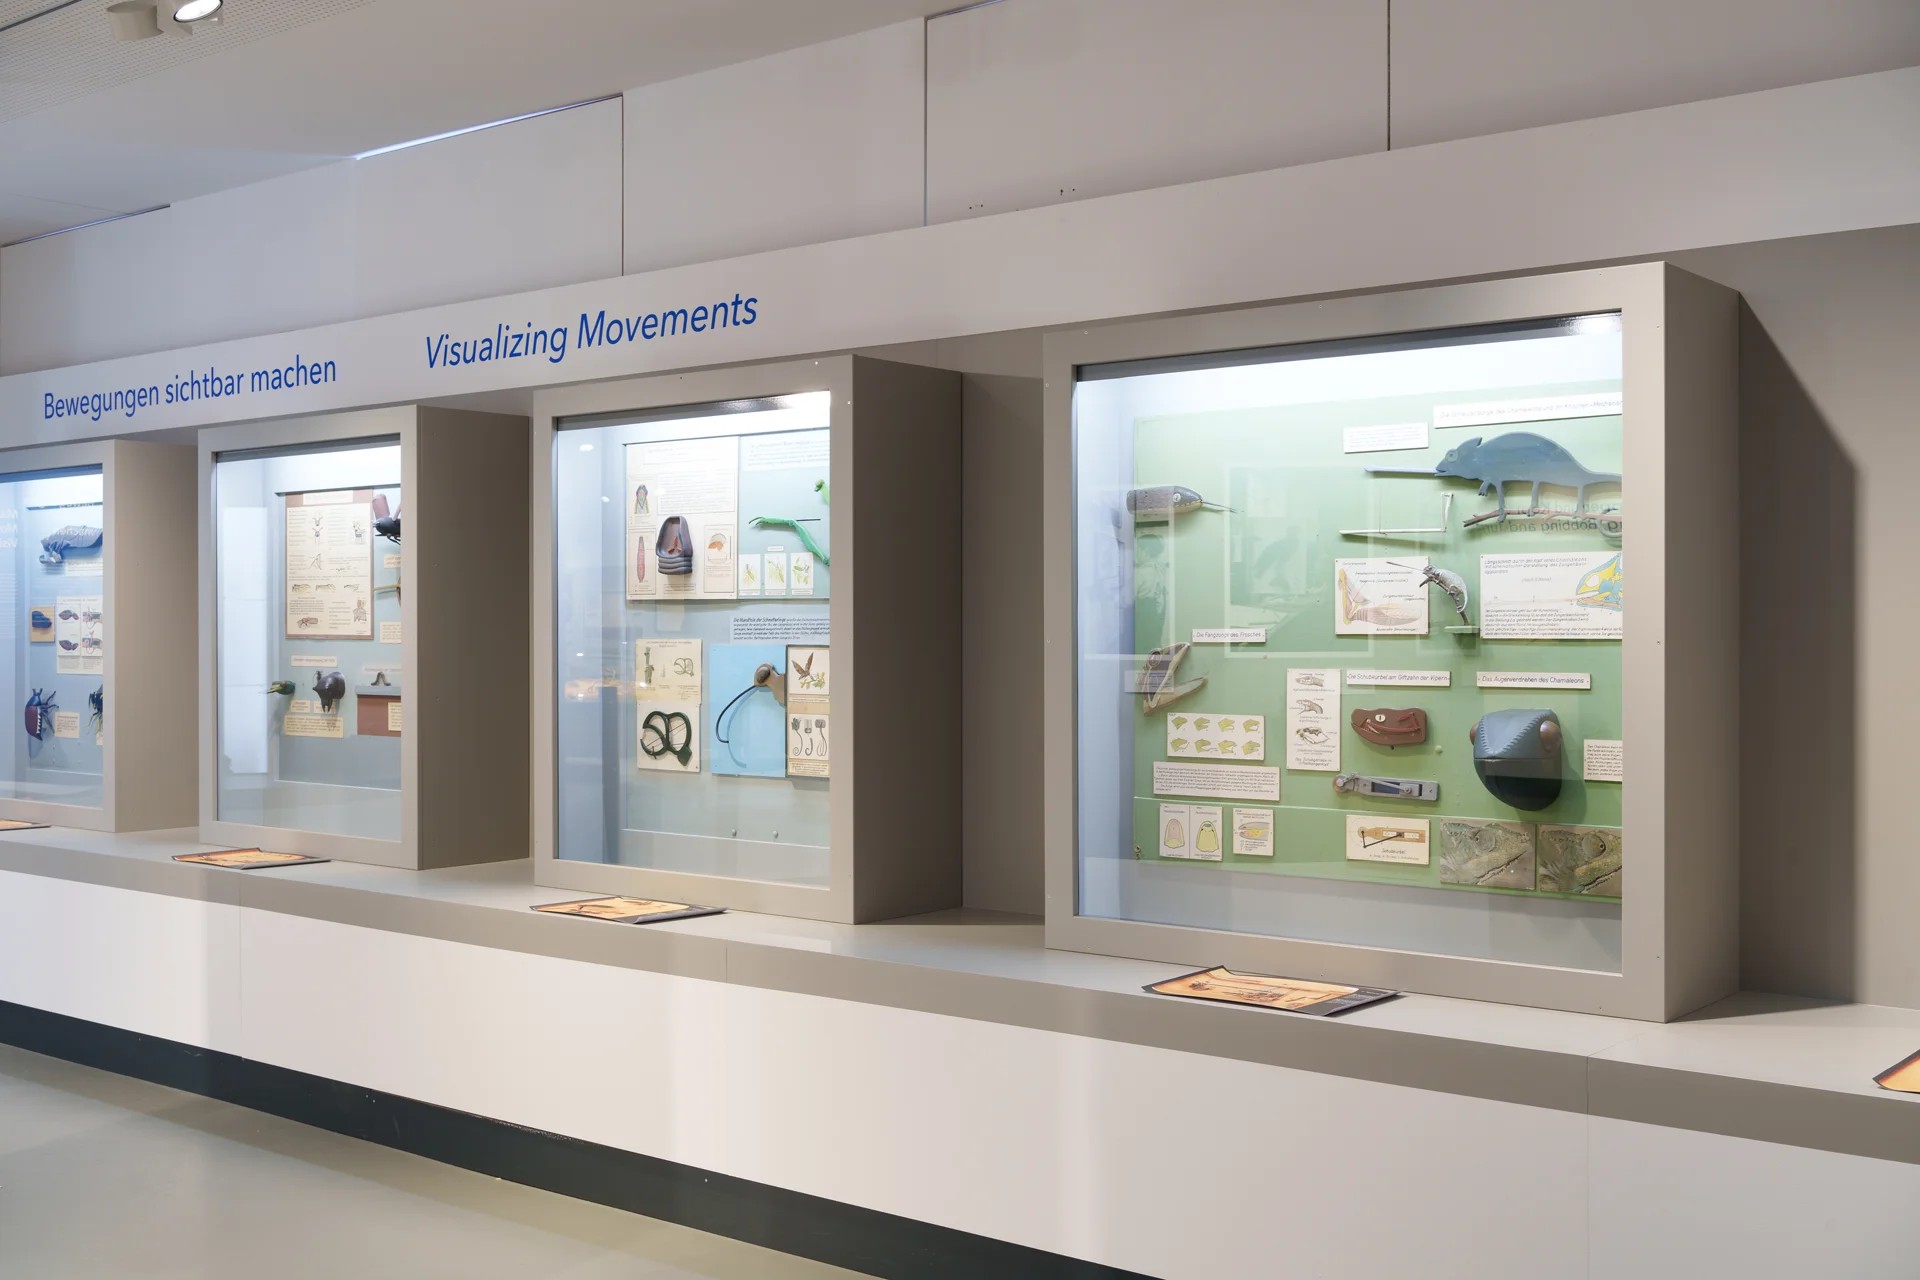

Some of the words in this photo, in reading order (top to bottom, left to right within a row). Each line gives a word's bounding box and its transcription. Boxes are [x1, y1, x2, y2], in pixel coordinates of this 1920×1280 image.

[425, 322, 568, 369] Visualizing
[576, 293, 759, 350] Movements
[43, 385, 160, 422] Bewegungen
[165, 366, 245, 403] sichtbar
[250, 353, 337, 393] machen
[1205, 631, 1229, 639] Fangzunge
[1357, 673, 1388, 681] Schubkurbel
[1398, 674, 1419, 682] Giftzahn
[1420, 674, 1429, 682] der
[1430, 674, 1448, 683] Vipern
[1494, 676, 1537, 684] Augenverdrehen
